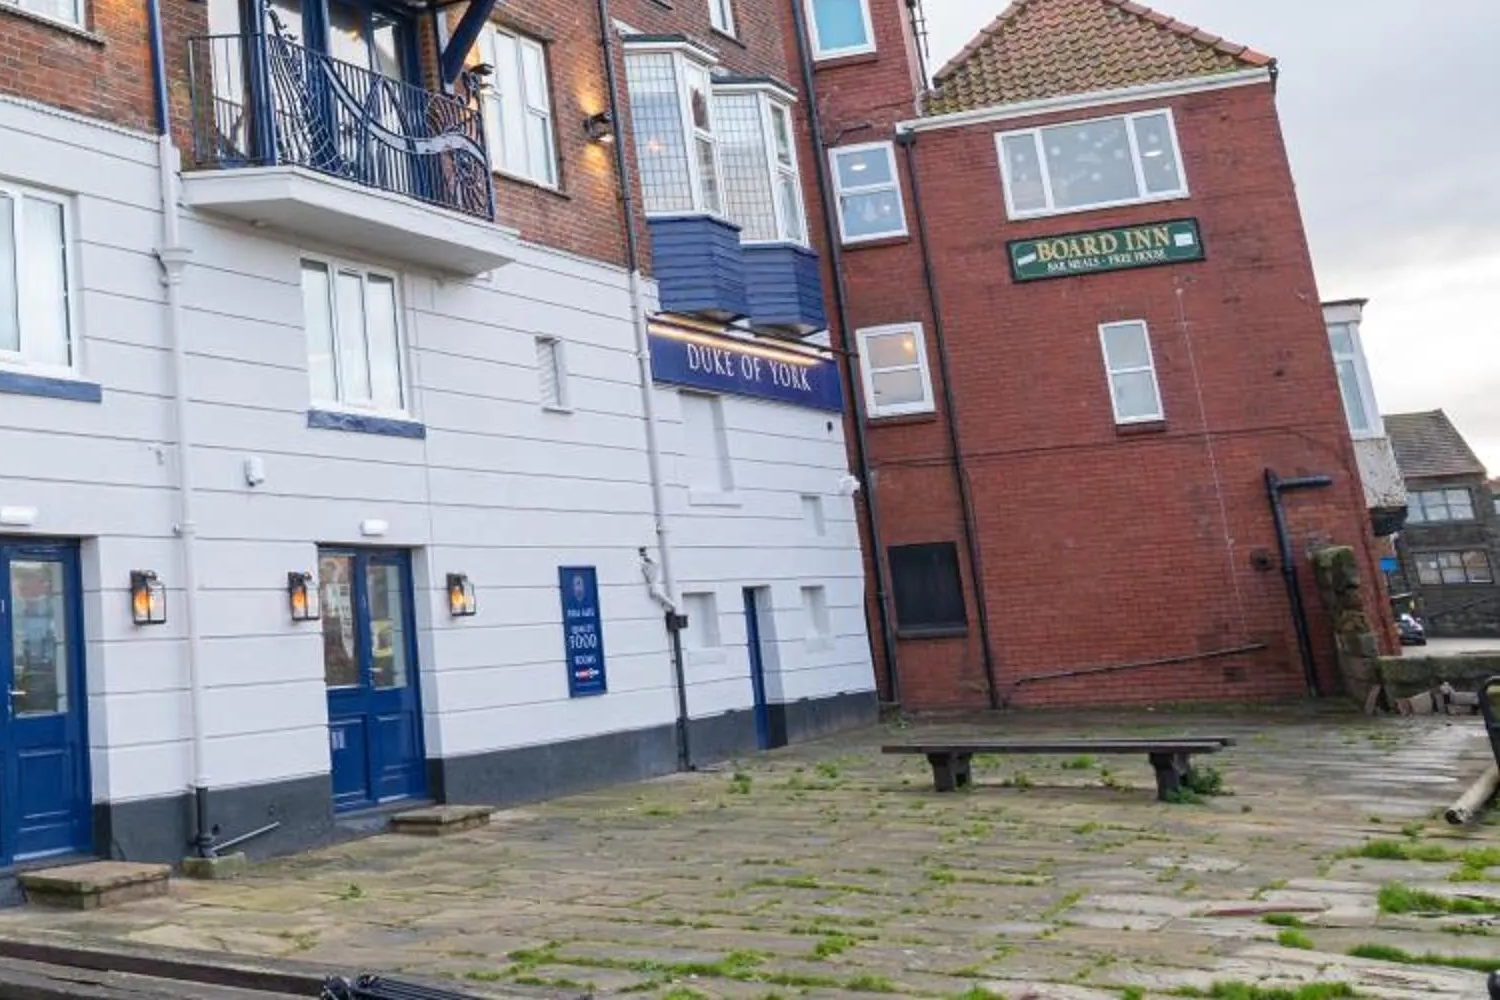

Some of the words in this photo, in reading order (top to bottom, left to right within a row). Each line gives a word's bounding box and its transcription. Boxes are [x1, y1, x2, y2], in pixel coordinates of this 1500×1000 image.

[1036, 233, 1117, 261] BOARD
[1125, 226, 1171, 251] INN
[687, 343, 735, 377] DUKE
[741, 354, 762, 381] OF
[769, 360, 811, 392] YORK
